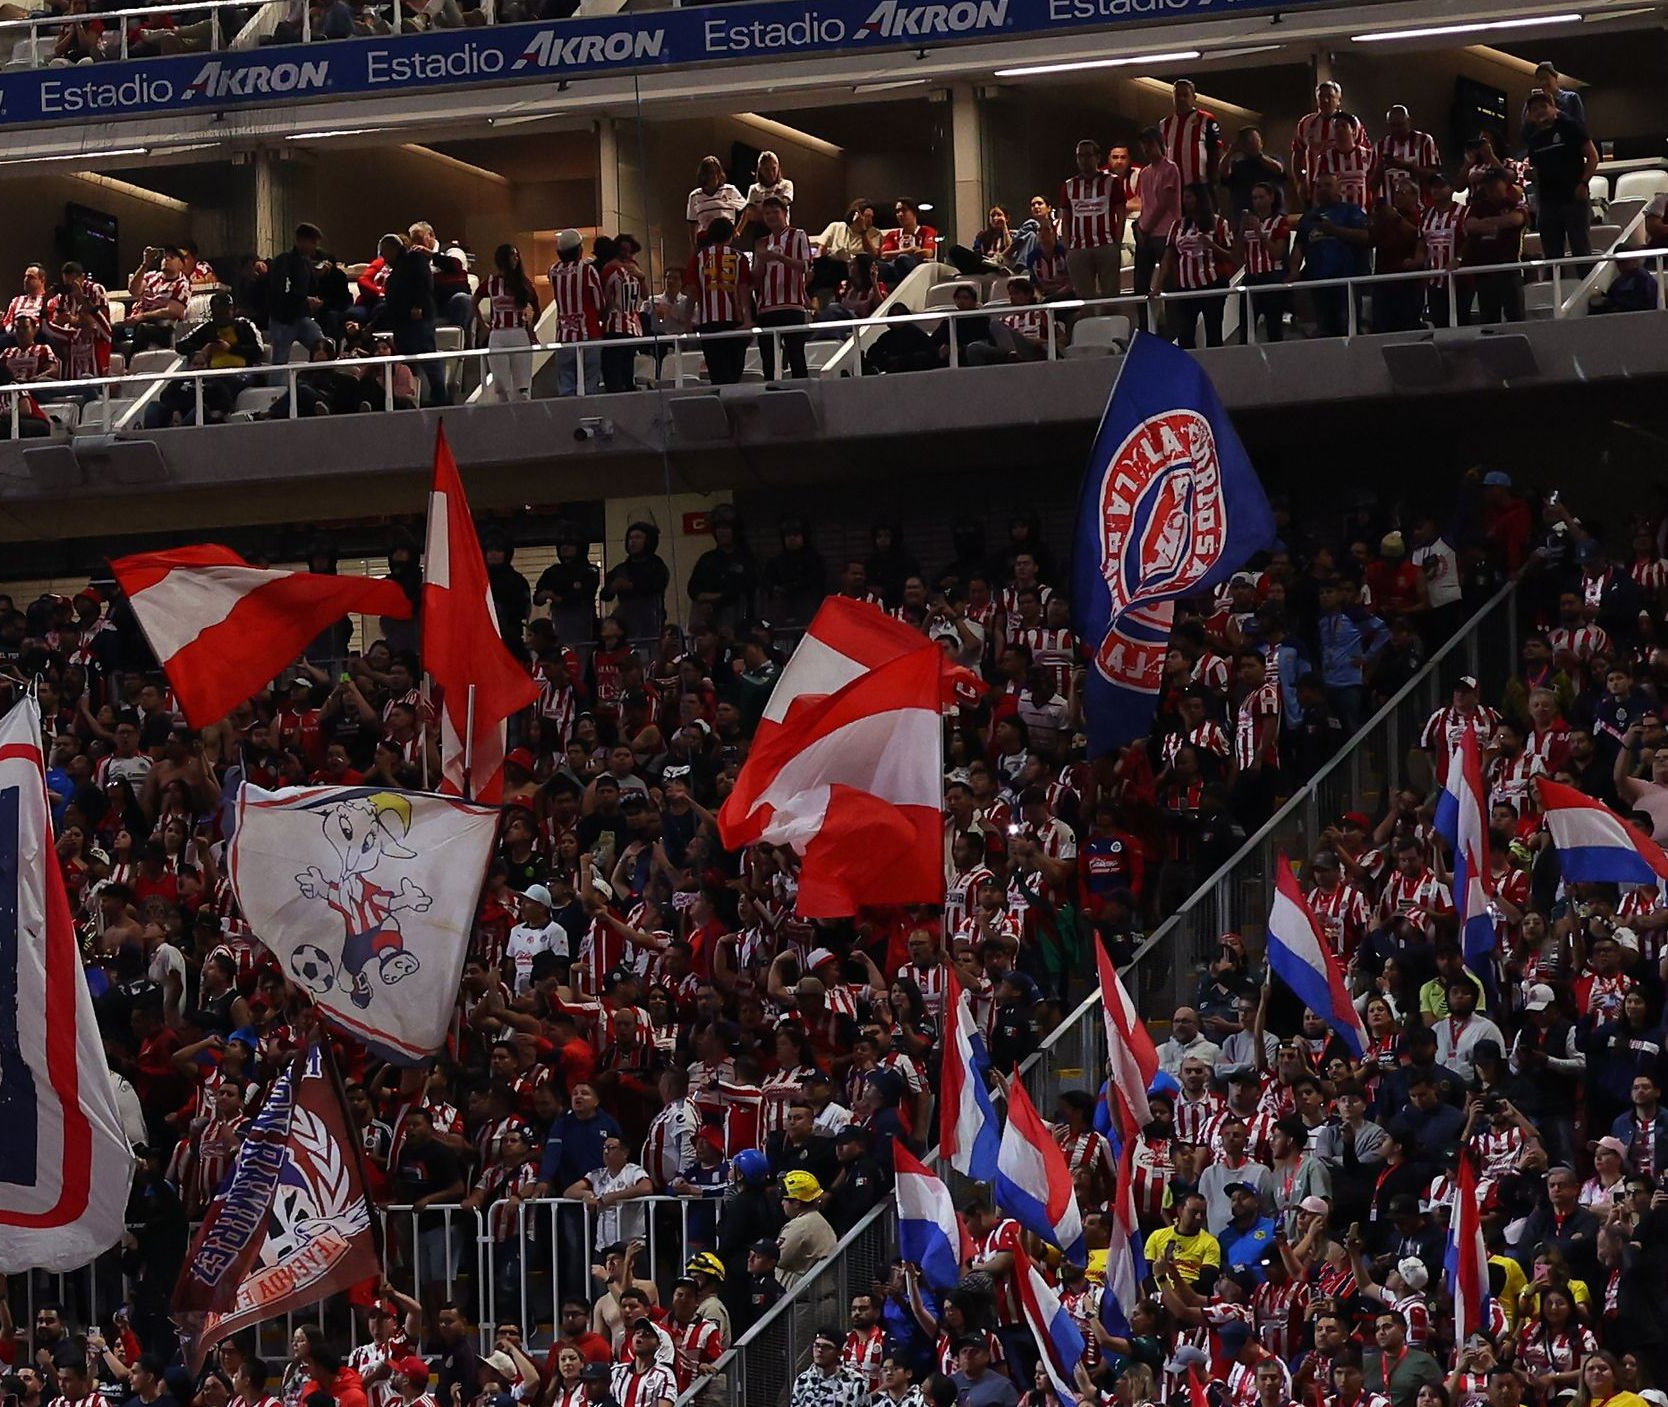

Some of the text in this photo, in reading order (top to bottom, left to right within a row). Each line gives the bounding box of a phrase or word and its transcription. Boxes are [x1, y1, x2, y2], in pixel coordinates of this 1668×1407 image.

[704, 0, 1007, 52] Estadio AKRON
[368, 29, 664, 82] Estadio AKRON
[41, 61, 328, 112] Estadio AKRON
